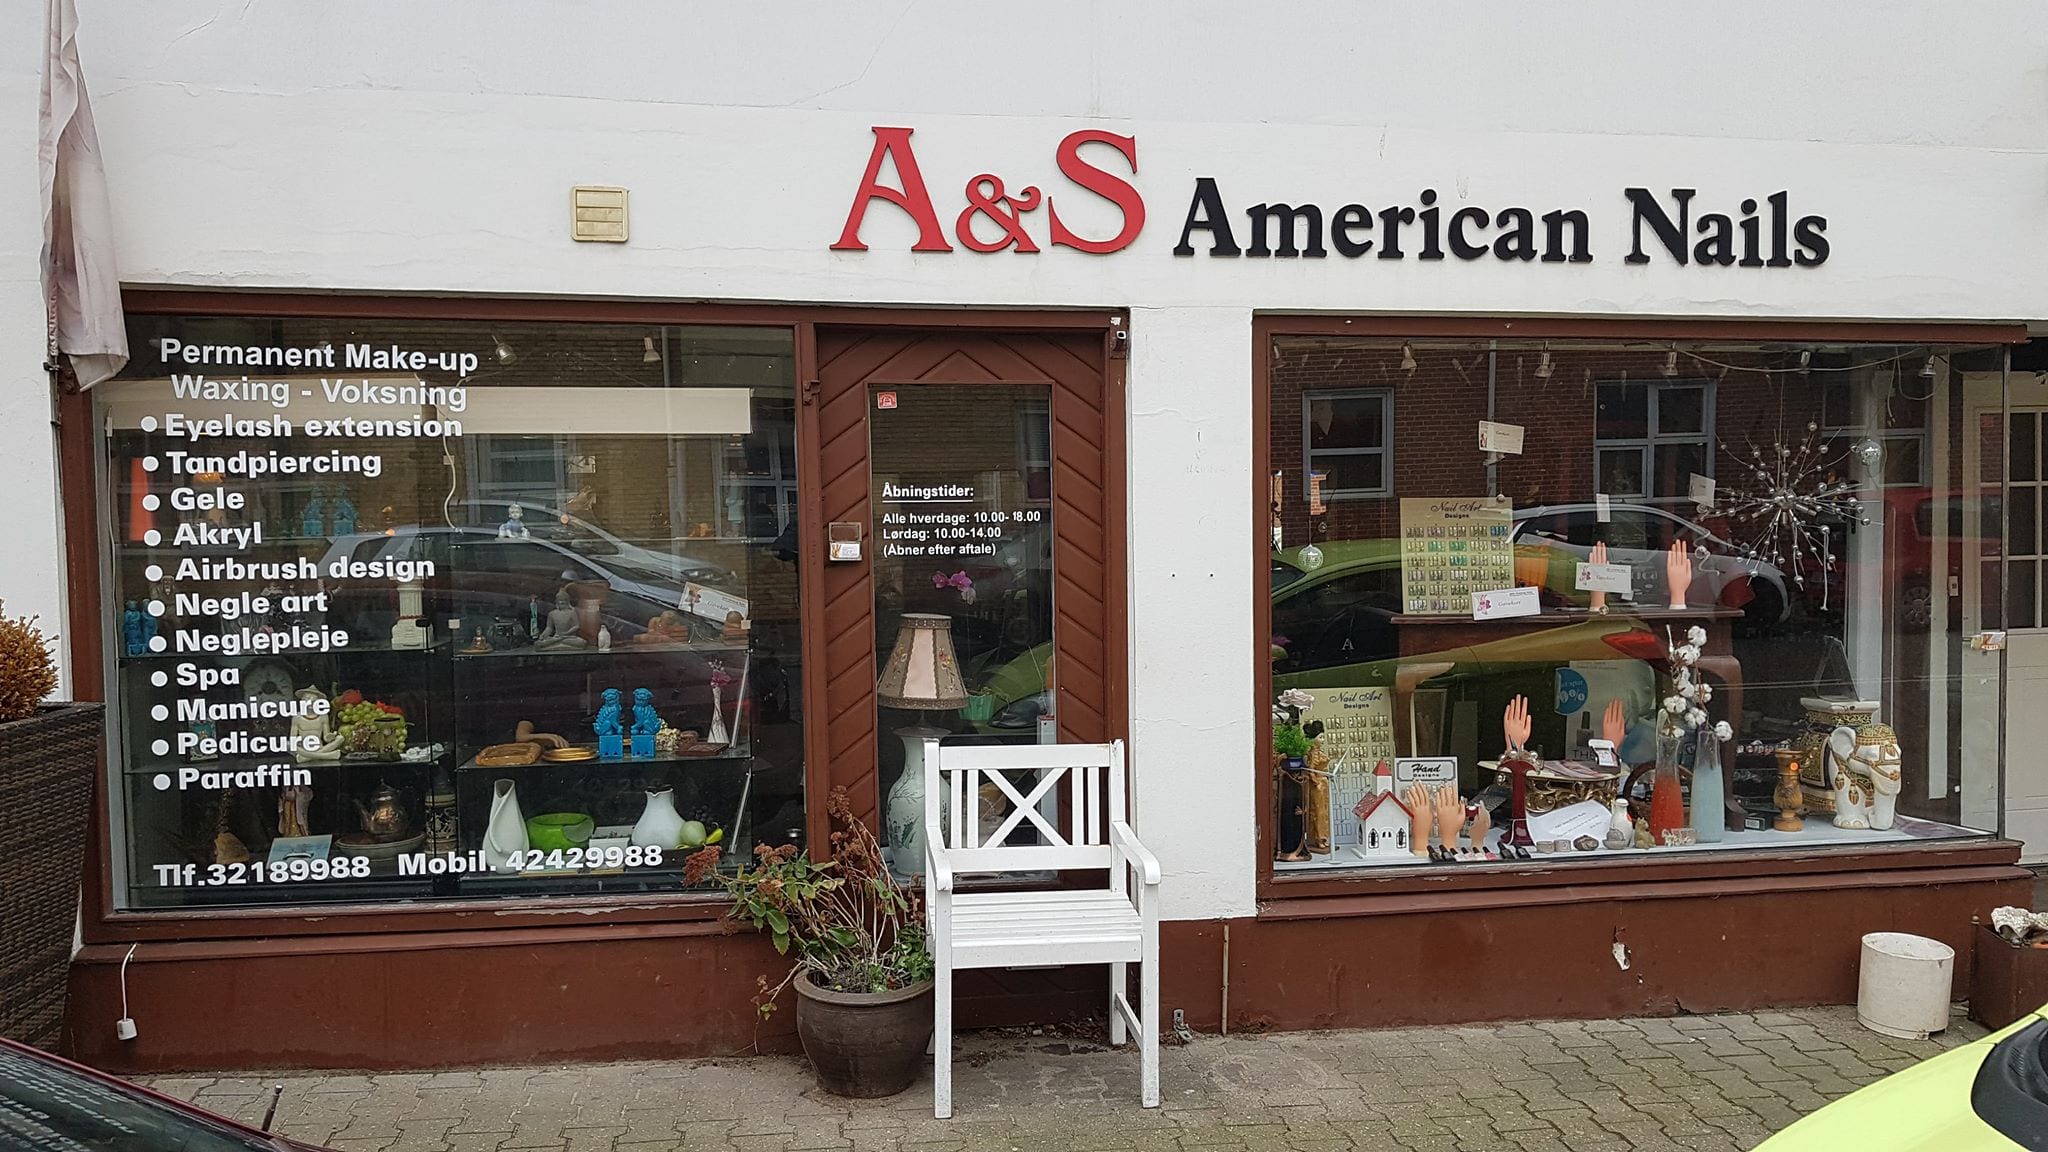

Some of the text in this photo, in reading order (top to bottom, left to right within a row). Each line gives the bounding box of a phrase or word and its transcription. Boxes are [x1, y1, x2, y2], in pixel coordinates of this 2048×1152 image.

[829, 126, 1831, 268] A&S American Nails
[160, 338, 479, 375] Permanent Make-up
[171, 375, 290, 407] Waxing
[320, 379, 468, 411] Voksning
[165, 414, 463, 442] Eyelash extension
[165, 449, 382, 478] Tandpiercing
[170, 487, 246, 511] Gele
[882, 482, 974, 499] Åbningstider:
[882, 511, 1041, 526] Alle hverdage: 10.00- 18.00
[1430, 500, 1483, 512] Nail Art
[1444, 512, 1470, 520] Designs
[173, 521, 263, 549] Akryl
[883, 526, 1002, 541] Lørdag: 10.00-14.00
[928, 544, 956, 555] efter
[958, 542, 997, 556] aftale)
[174, 556, 435, 582] Airbrush design
[175, 591, 328, 619] Negle art
[175, 624, 350, 655] Neglepleje
[175, 664, 241, 690] Spa
[175, 696, 331, 722] Manicure
[1329, 690, 1383, 703] Nail Art
[1343, 702, 1370, 711] Designs
[177, 731, 321, 756] Pedicure
[178, 766, 313, 790] Paraffin
[1411, 763, 1441, 773] Hand
[153, 844, 664, 888] Tlf.32189988 Mobil. 42429988
